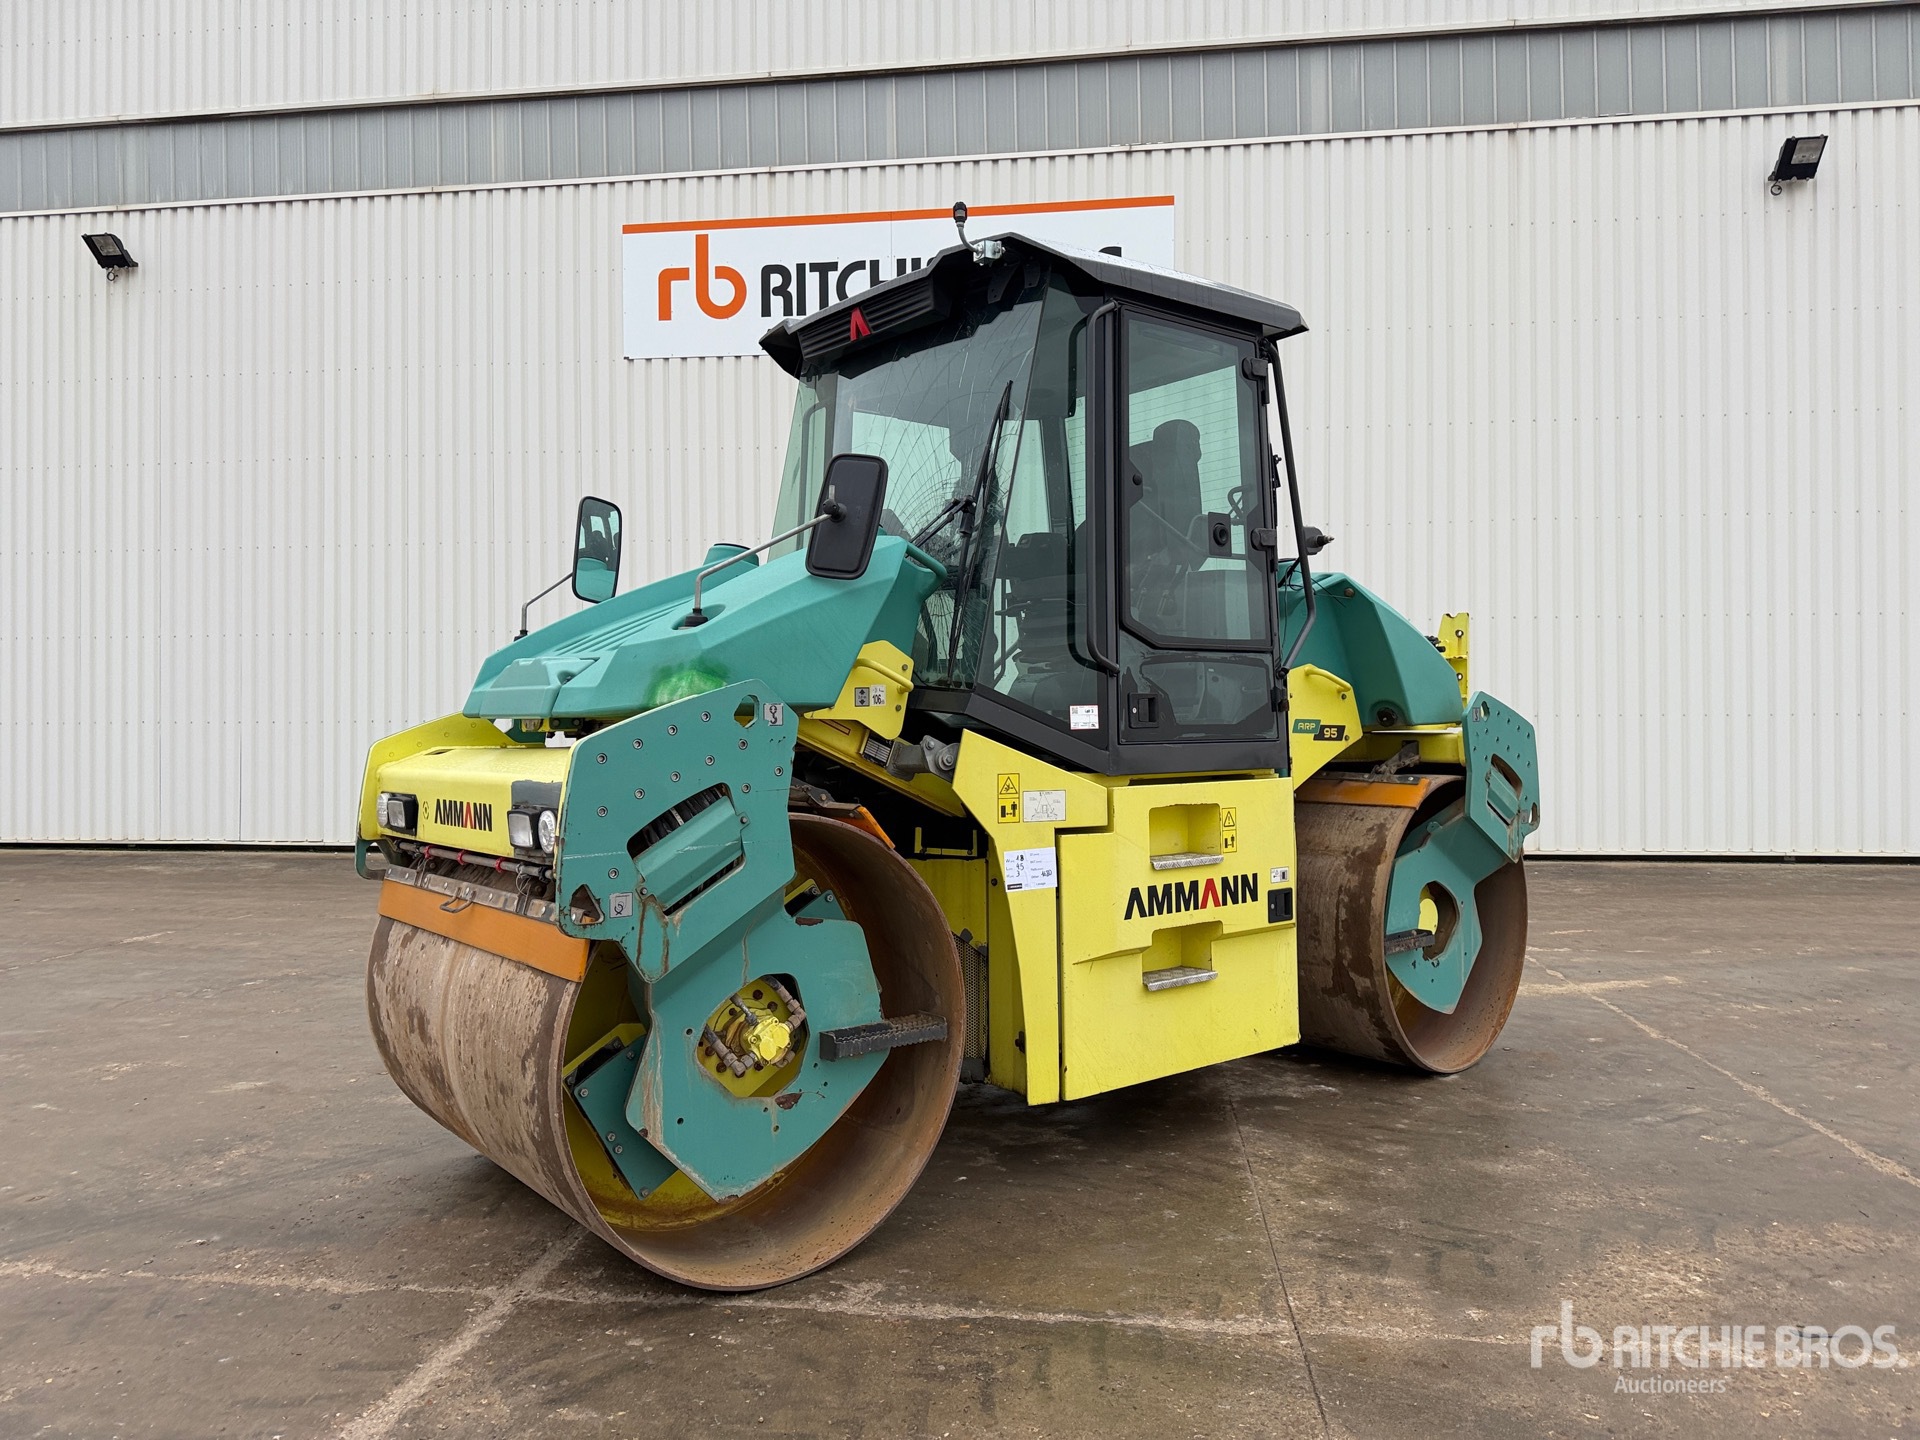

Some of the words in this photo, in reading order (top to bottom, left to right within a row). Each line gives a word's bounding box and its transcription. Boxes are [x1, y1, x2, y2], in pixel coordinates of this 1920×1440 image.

[658, 233, 747, 321] rb
[761, 256, 936, 318] RITCH
[1297, 722, 1316, 730] ARP
[1323, 727, 1338, 738] 95
[434, 798, 492, 832] AMMANN
[1124, 872, 1258, 920] AMMANN
